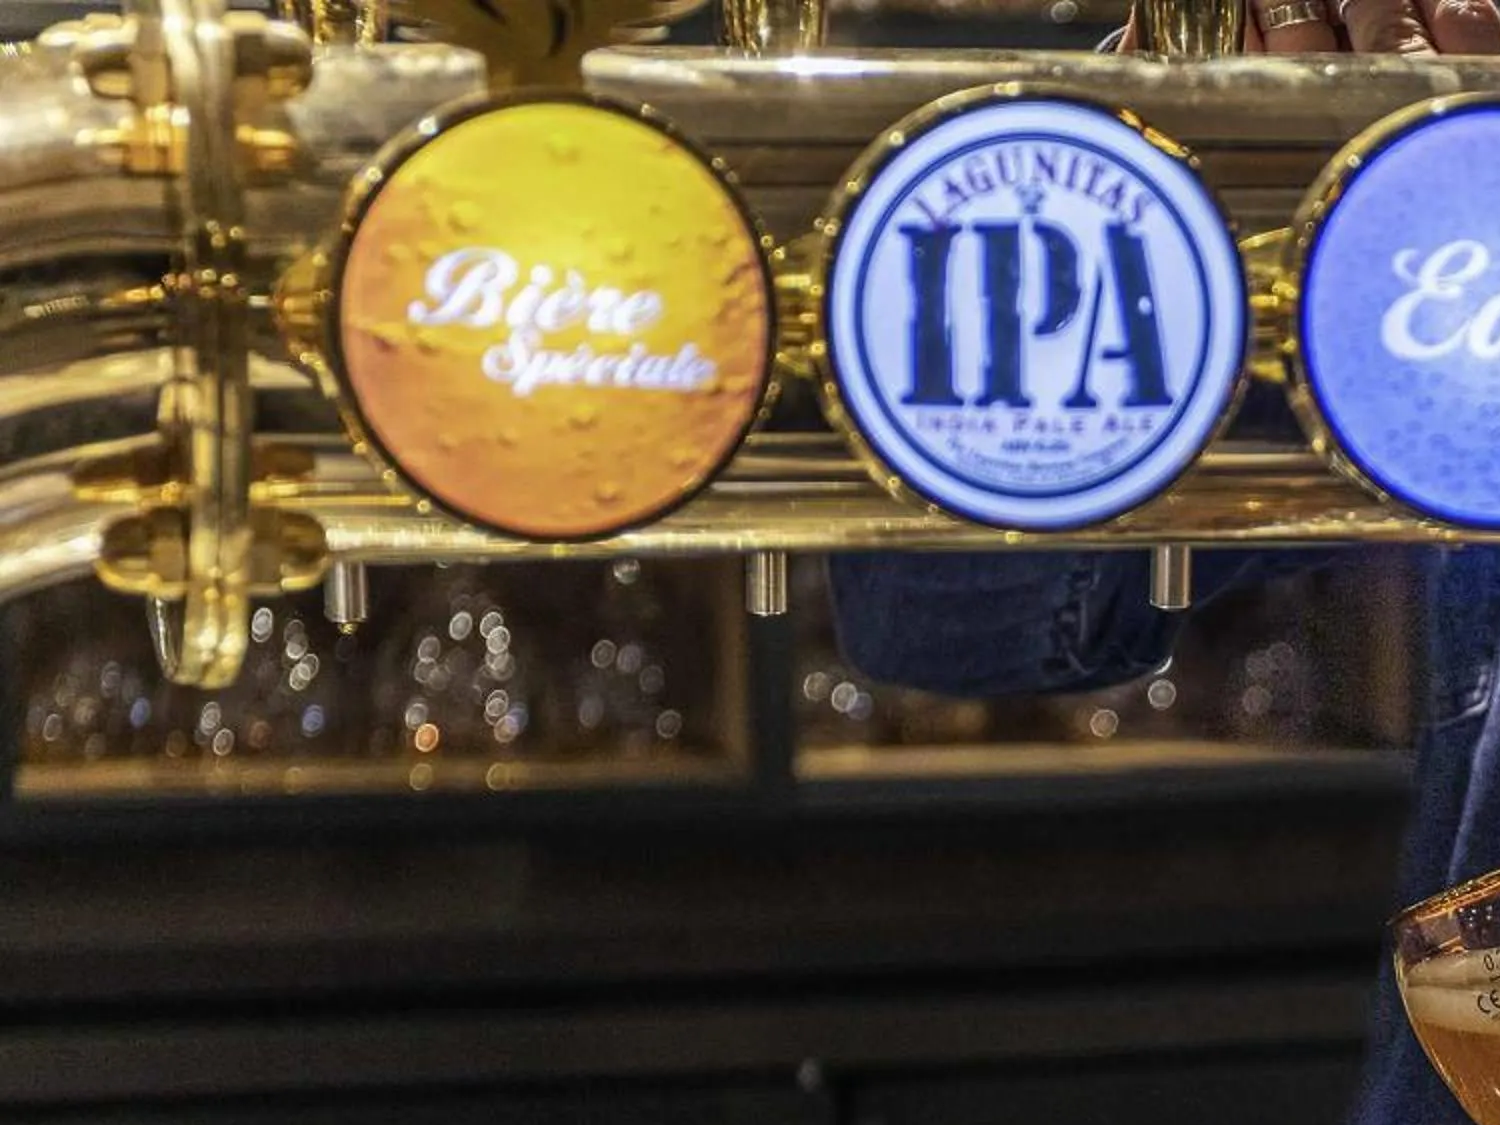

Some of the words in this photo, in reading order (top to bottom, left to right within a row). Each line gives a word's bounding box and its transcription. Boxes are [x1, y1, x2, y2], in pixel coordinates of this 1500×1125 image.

[911, 145, 1151, 228] LAGUNITAS
[407, 246, 662, 334] Bière
[900, 222, 1173, 408] IPA
